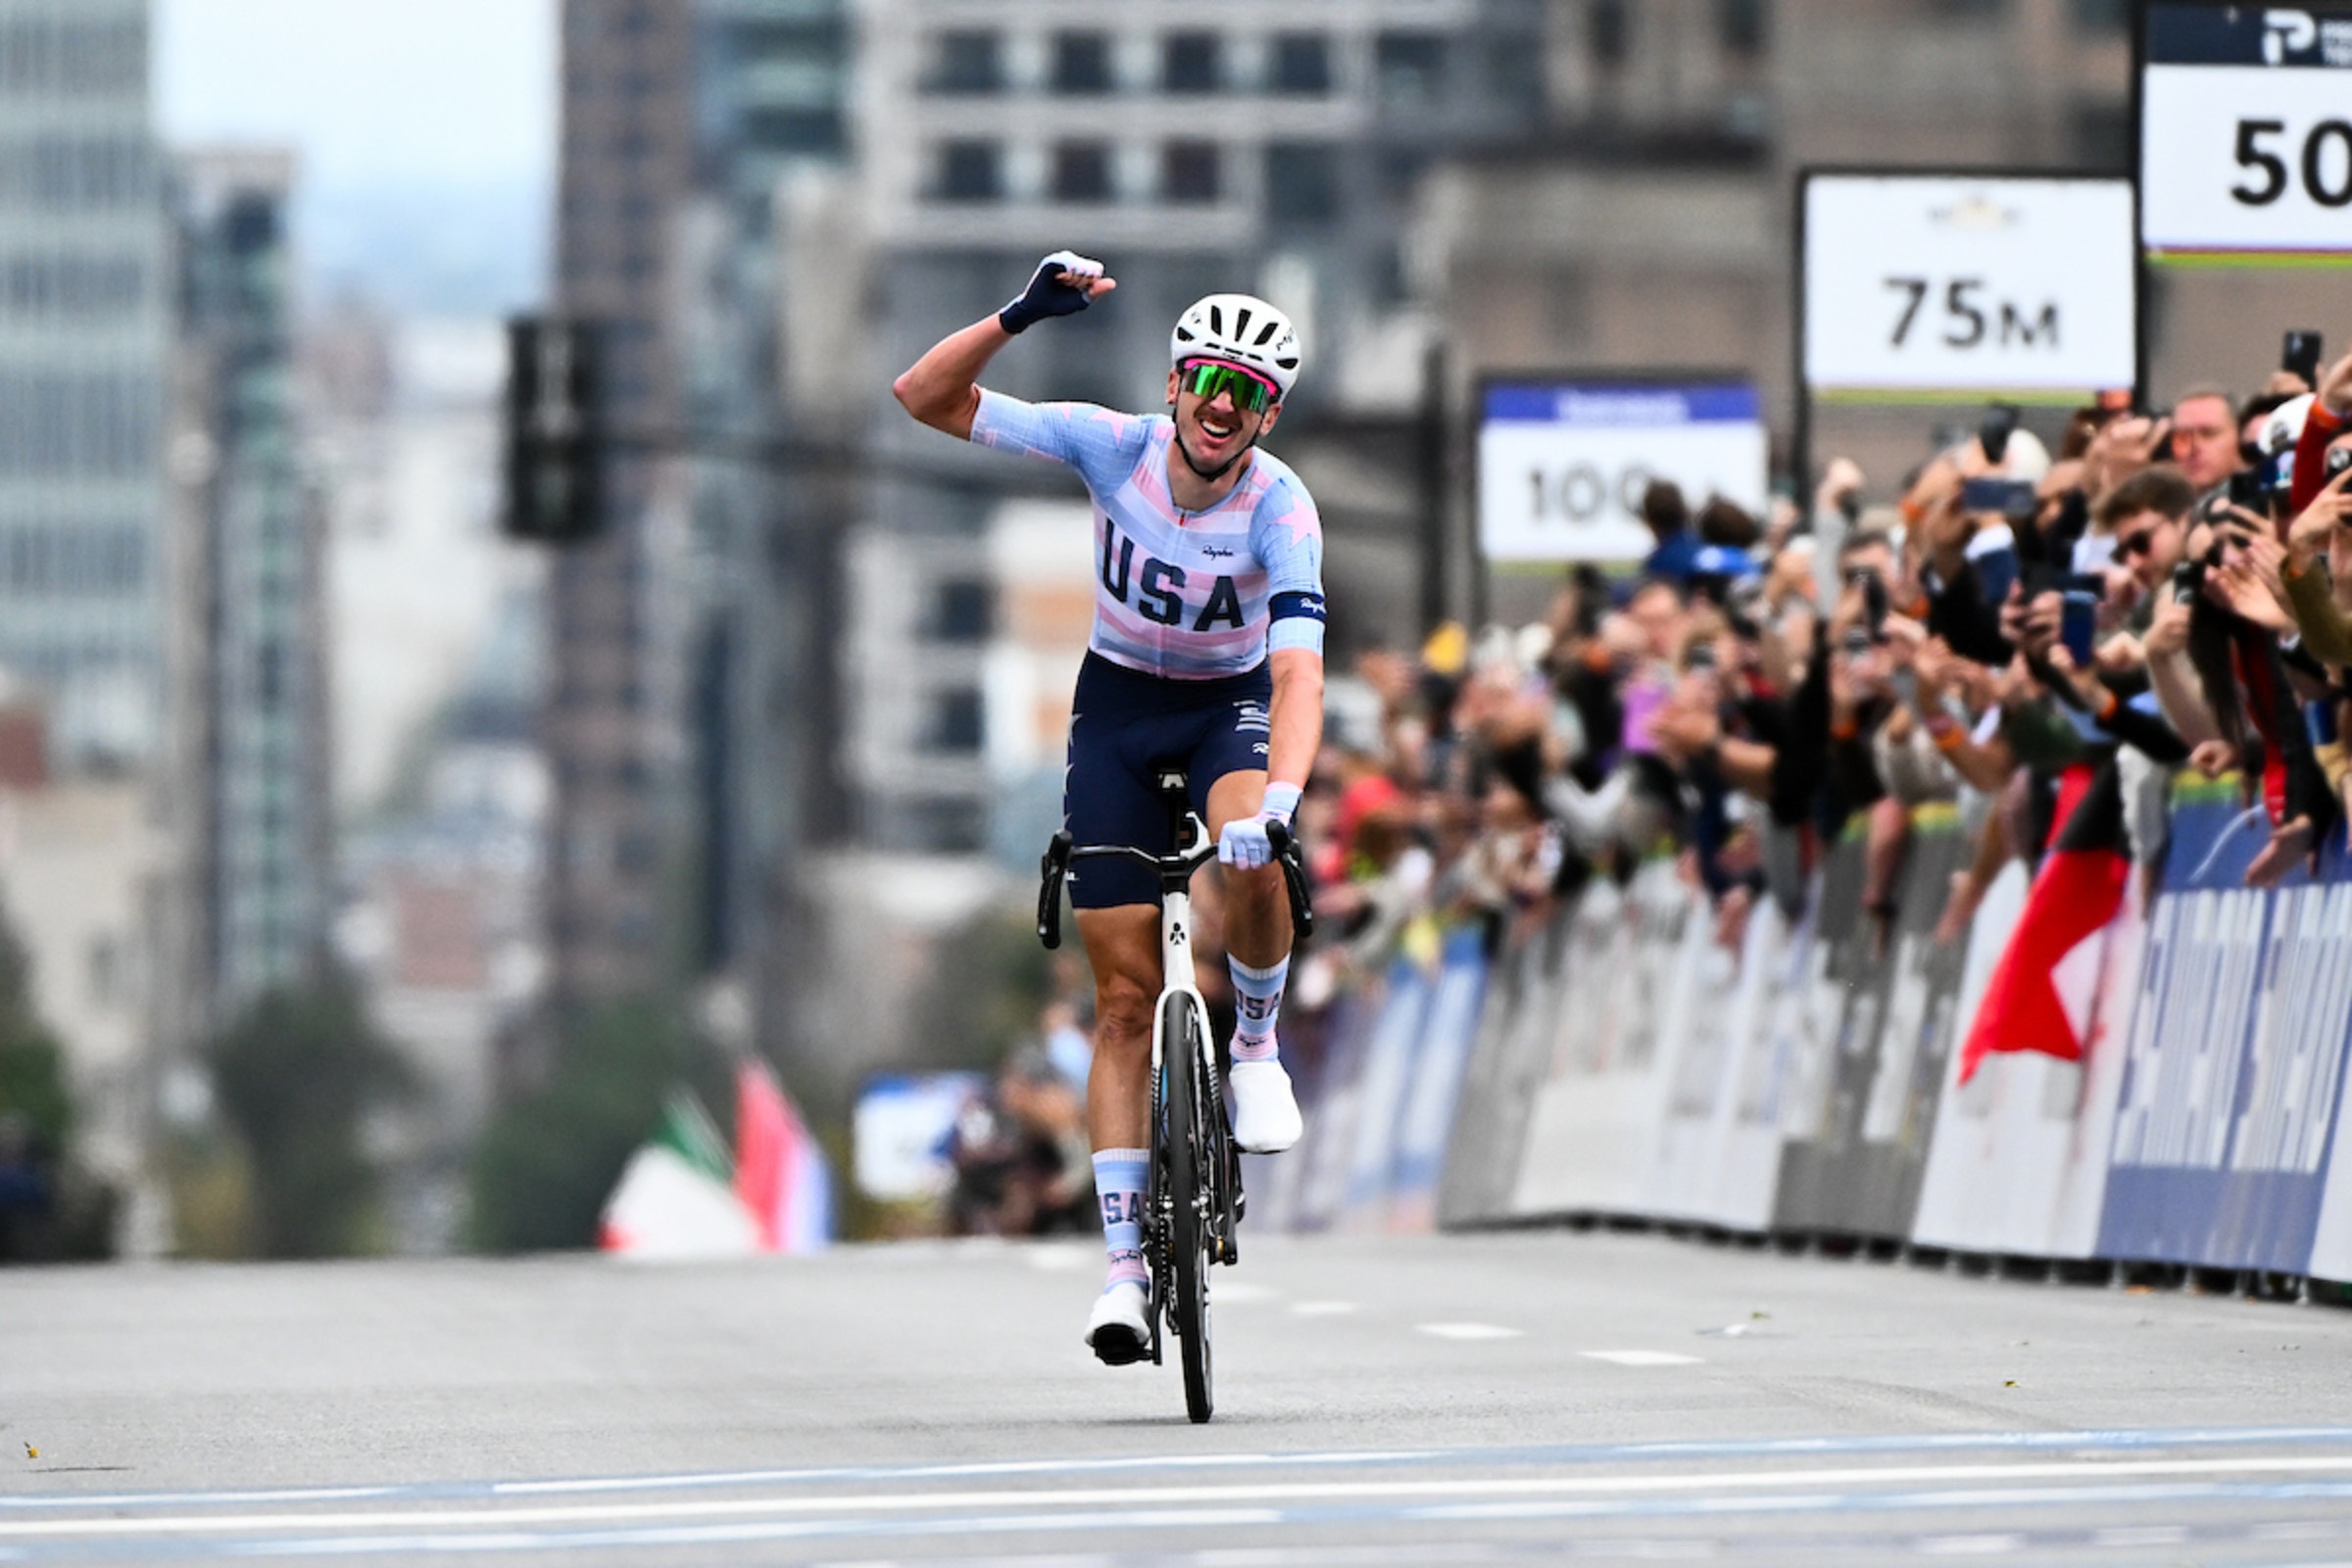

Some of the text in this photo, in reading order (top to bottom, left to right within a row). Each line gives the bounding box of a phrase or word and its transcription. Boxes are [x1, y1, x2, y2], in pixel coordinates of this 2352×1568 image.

[2230, 117, 2352, 209] 50
[1102, 516, 1246, 632] USA
[1099, 1192, 1142, 1226] SA
